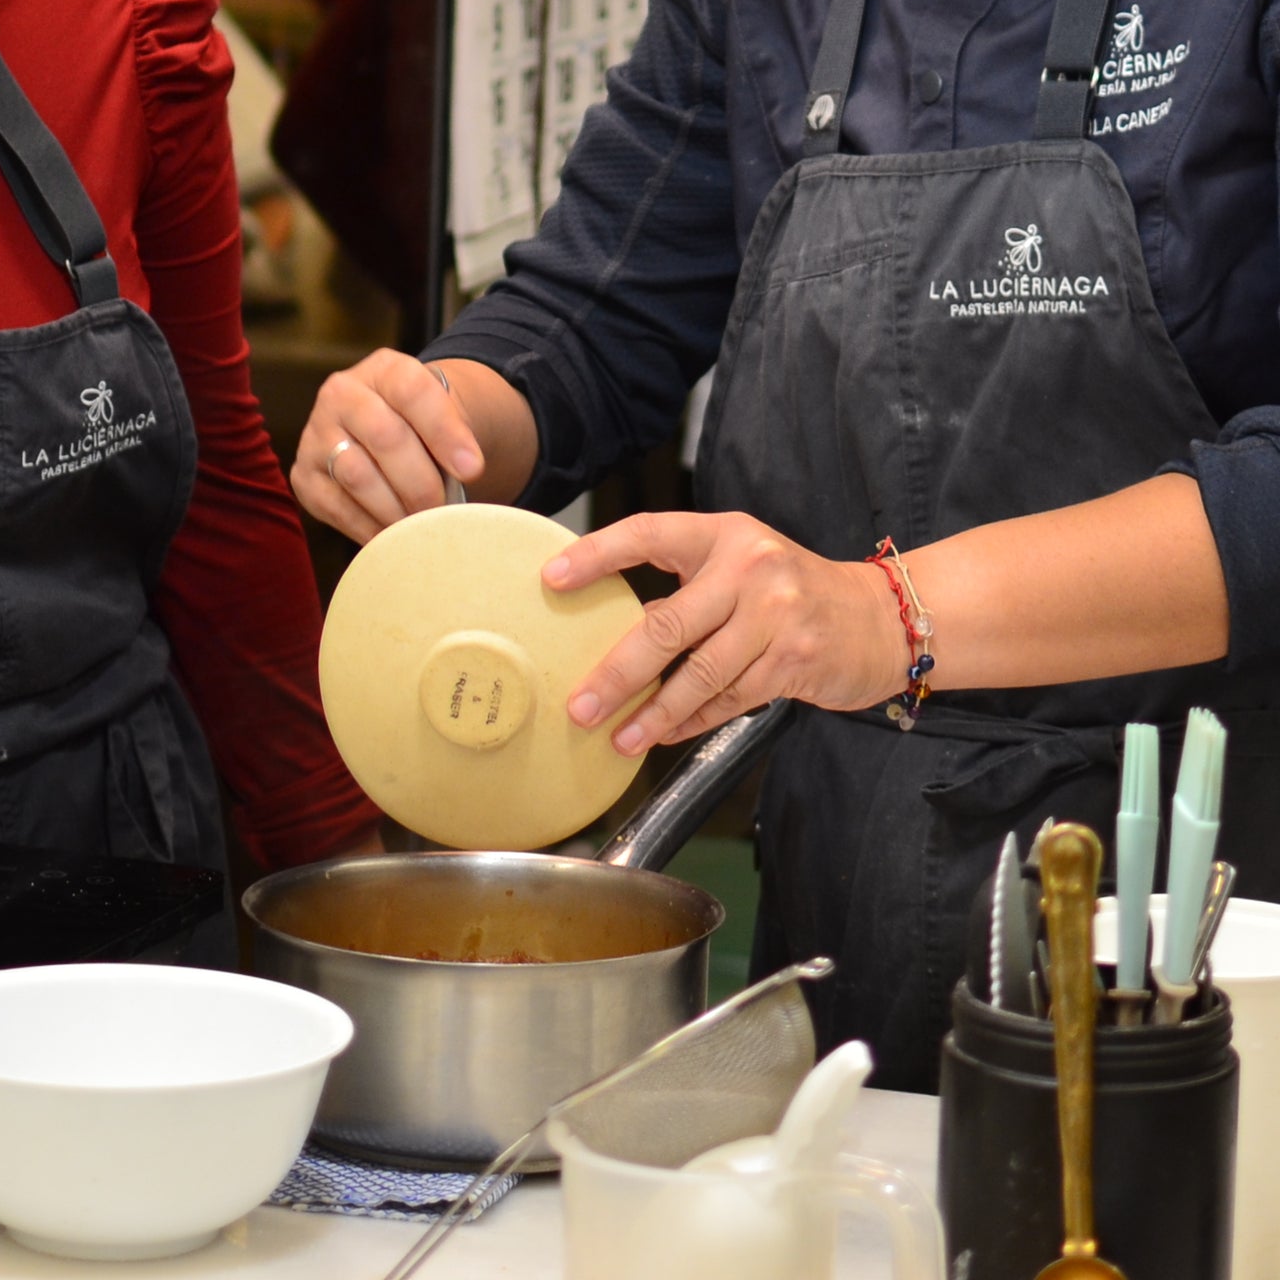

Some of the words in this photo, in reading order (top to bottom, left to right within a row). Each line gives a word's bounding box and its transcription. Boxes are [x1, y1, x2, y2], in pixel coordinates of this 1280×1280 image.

[929, 280, 959, 300] LA
[969, 274, 1110, 300] LUCIÉRNAGA
[949, 298, 1025, 318] PASTELERÍA
[1027, 299, 1087, 315] NATURAL
[22, 448, 50, 468] LA
[58, 409, 157, 462] LUCIÉRNAGA
[40, 450, 103, 481] PASTELERÍA
